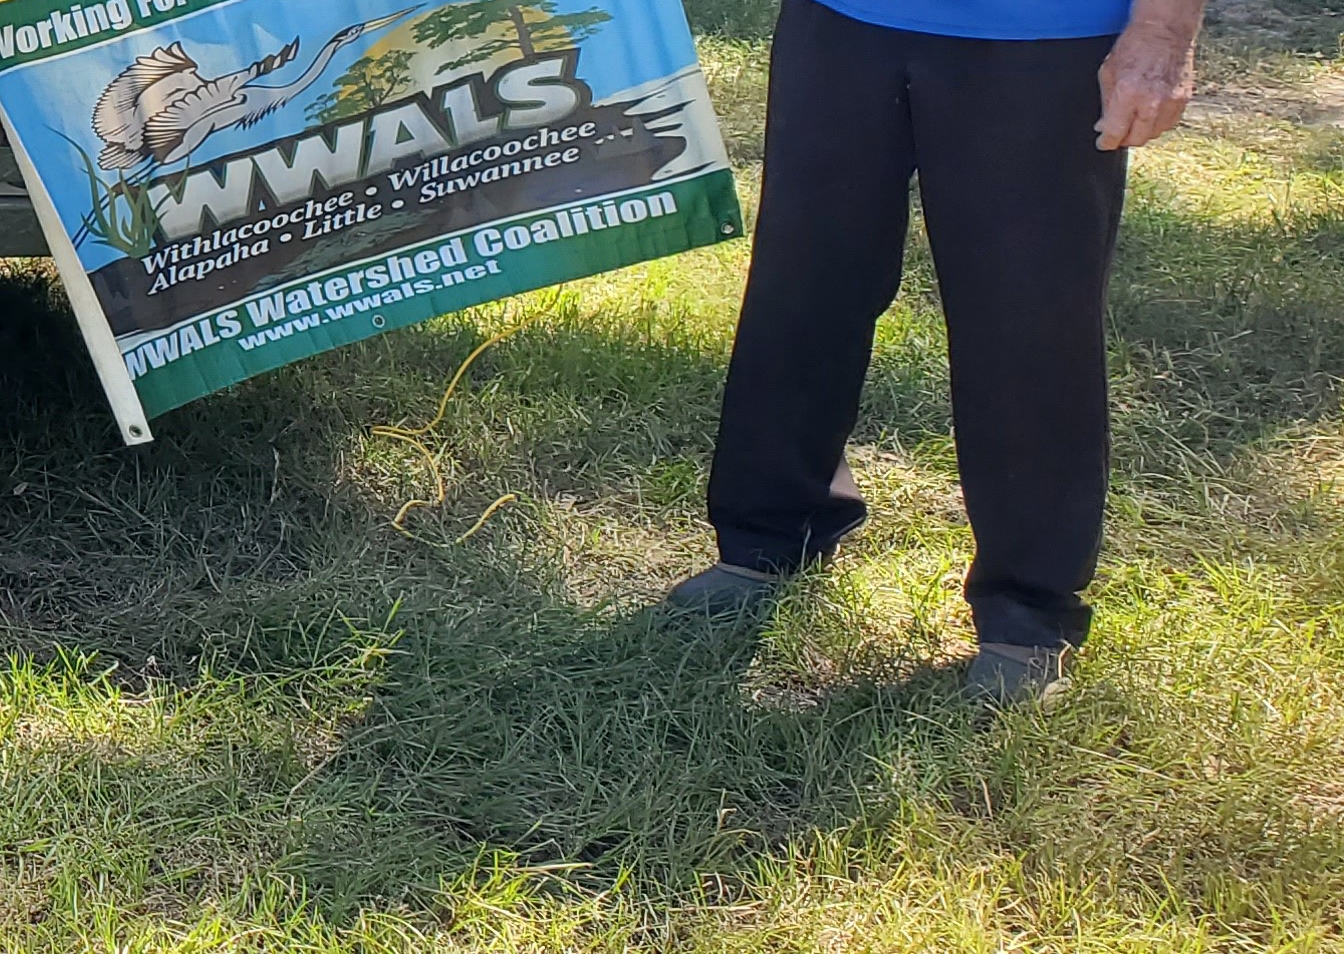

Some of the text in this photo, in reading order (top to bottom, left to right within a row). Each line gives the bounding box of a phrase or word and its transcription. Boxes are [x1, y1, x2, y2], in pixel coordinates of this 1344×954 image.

[141, 120, 597, 274] Withlacoochee Willacoochee
[146, 58, 578, 244] WWALS
[147, 147, 580, 296] Alapaha Little Suwannee
[125, 189, 678, 381] WWALS Watershed Coalition
[236, 259, 502, 352] www.wwals.net
